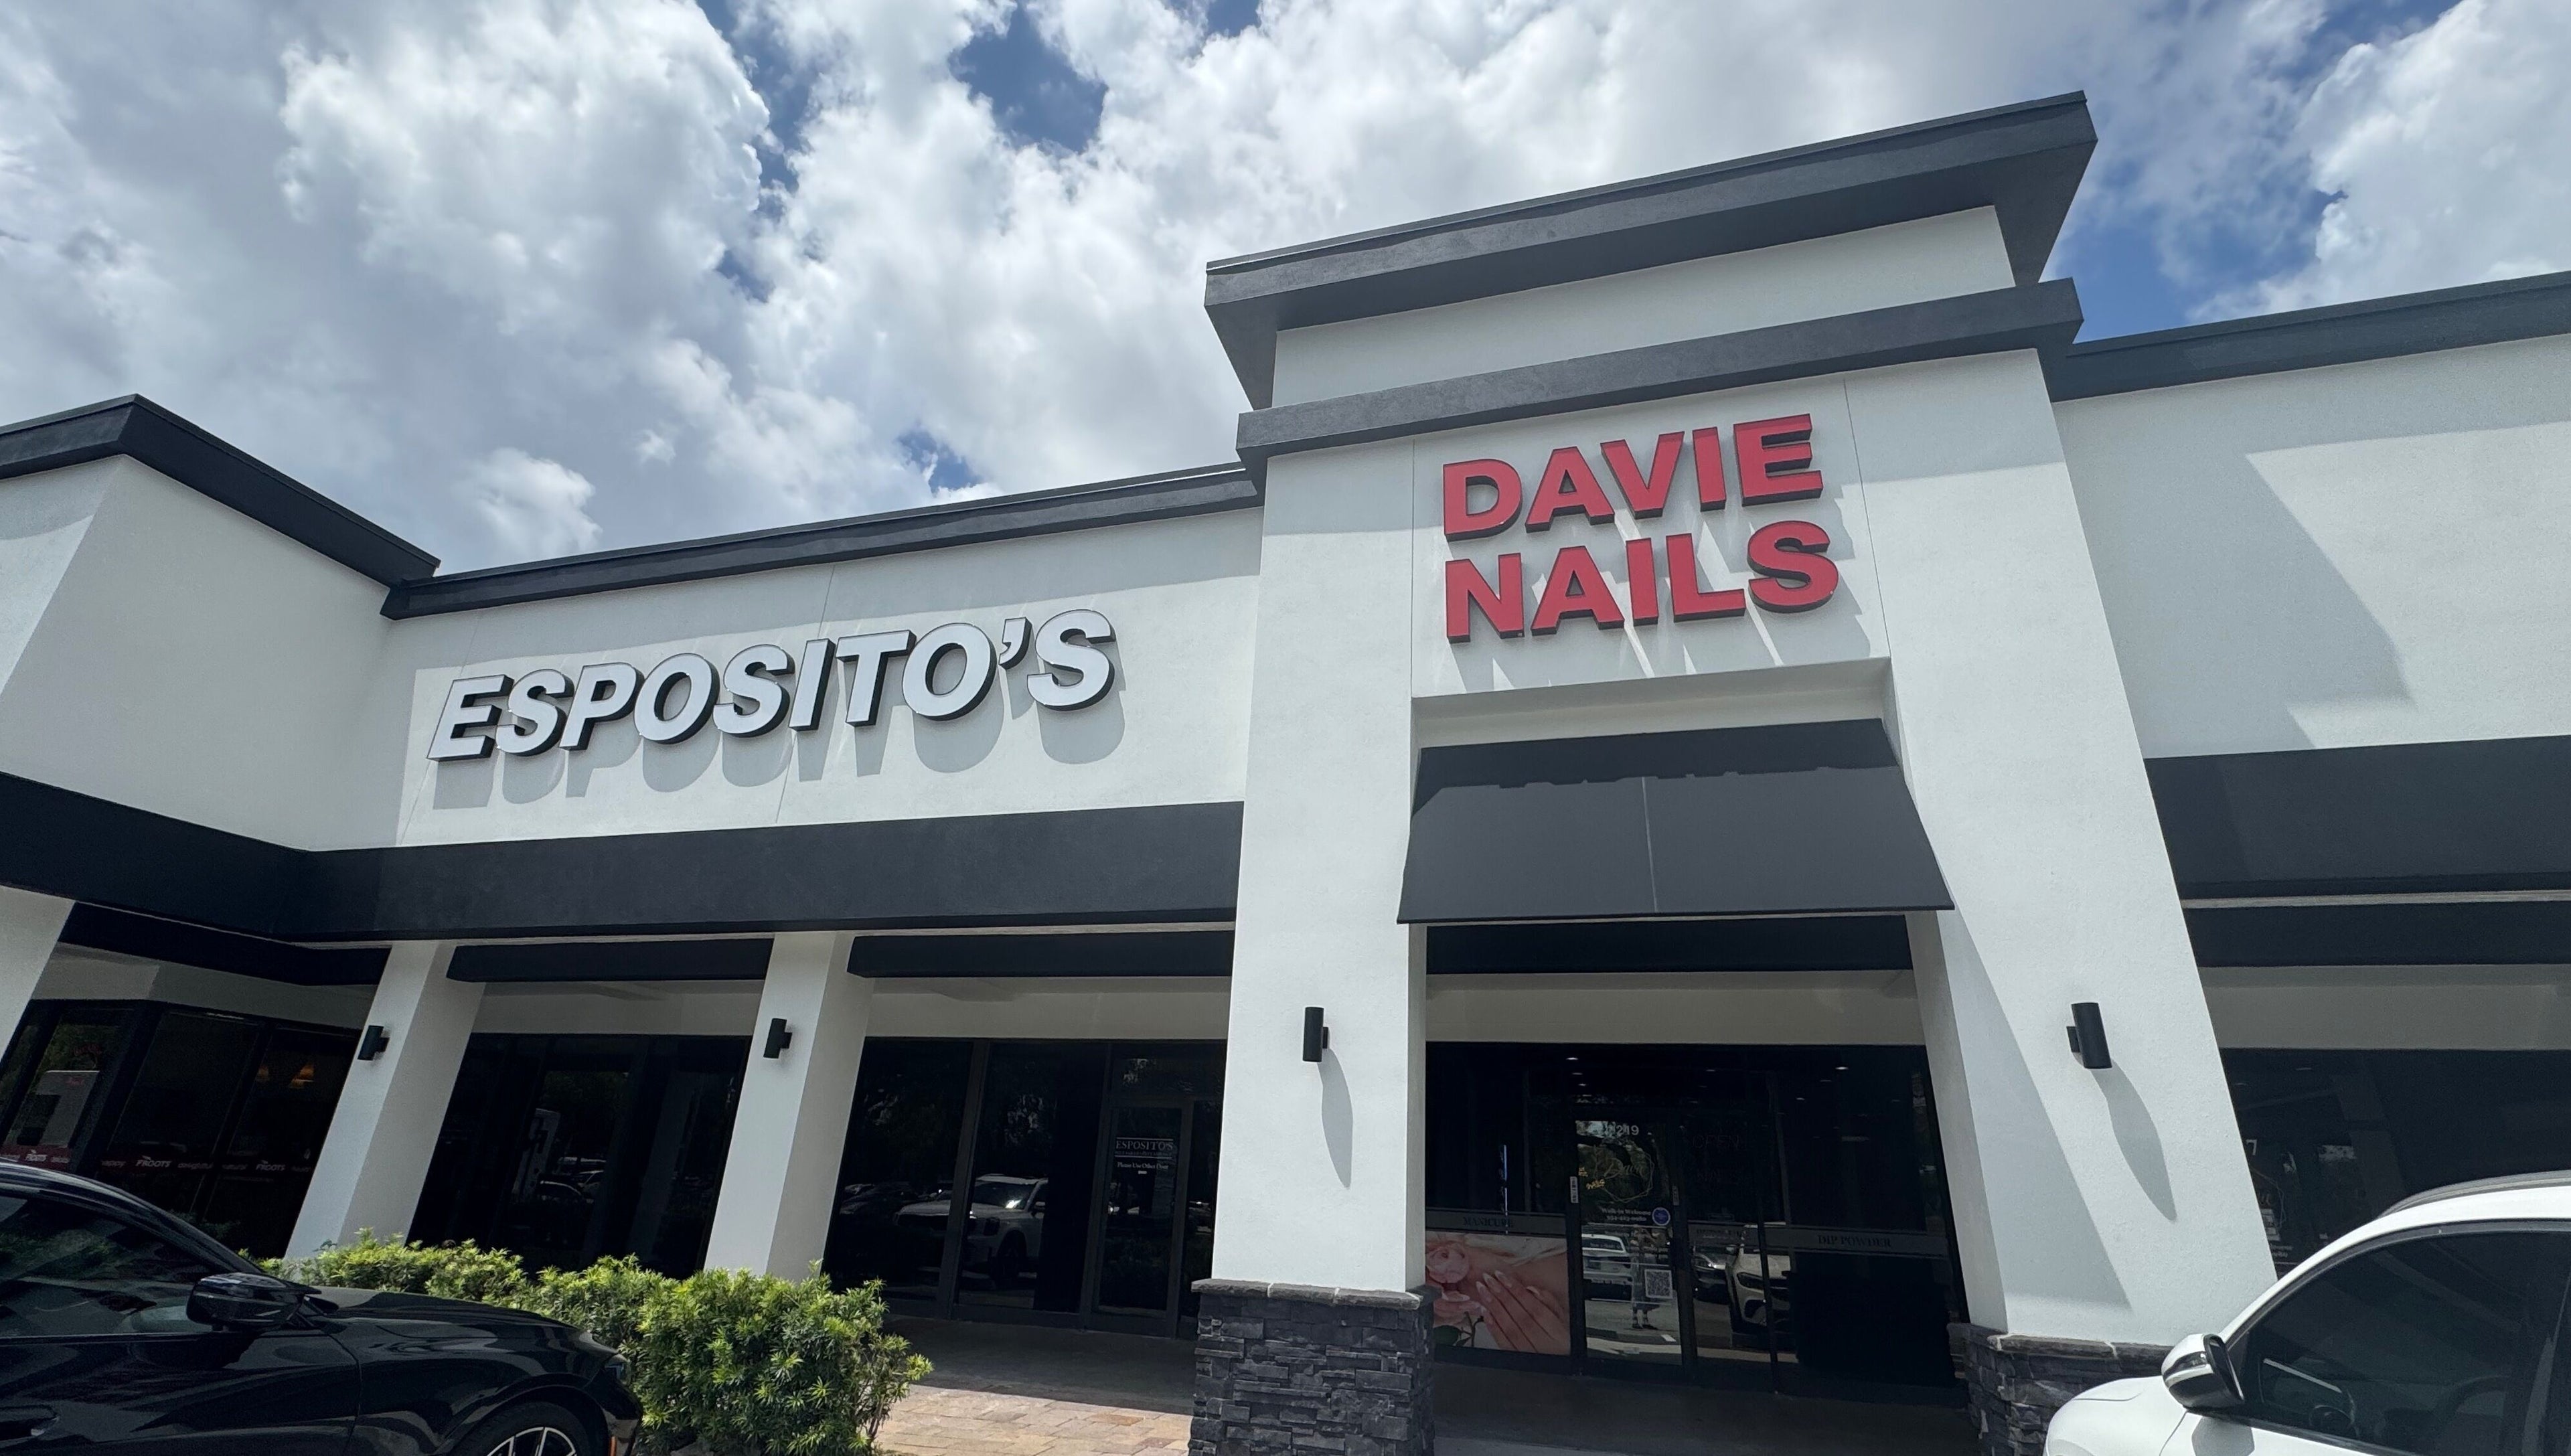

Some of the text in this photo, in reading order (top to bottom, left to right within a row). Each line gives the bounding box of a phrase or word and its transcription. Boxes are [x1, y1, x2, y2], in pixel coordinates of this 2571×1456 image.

[1442, 413, 1824, 542] DAVIE
[1445, 520, 1839, 643] NAILS
[426, 609, 1117, 762] ESPOSITO'S
[135, 1159, 172, 1168] FROOTS
[1115, 1140, 1174, 1151] ESPOSITO'S
[1817, 1234, 1891, 1247] DIP POWDER
